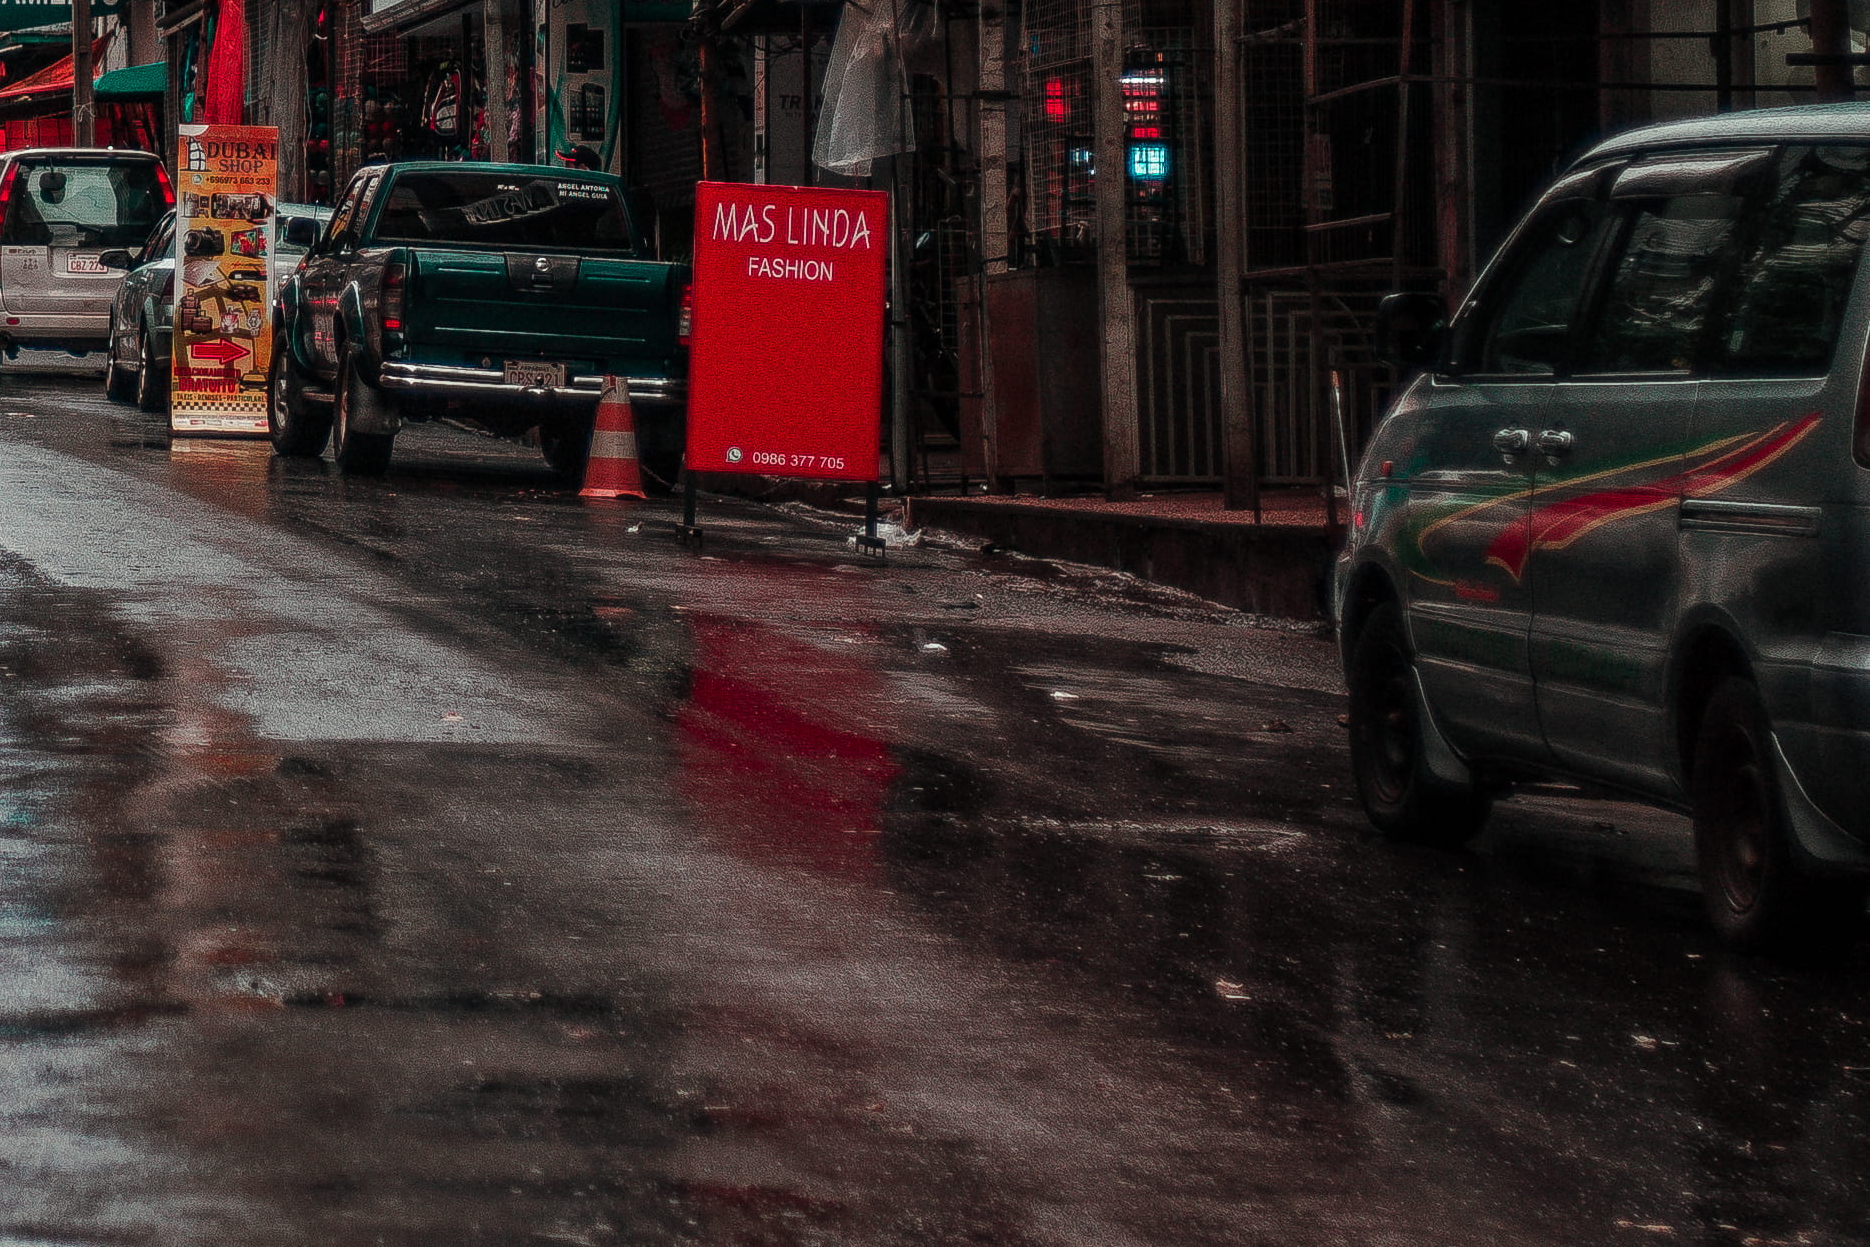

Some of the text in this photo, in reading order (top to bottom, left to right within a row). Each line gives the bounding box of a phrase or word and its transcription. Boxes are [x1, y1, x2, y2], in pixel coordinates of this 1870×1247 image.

[207, 141, 276, 160] DUBAI
[218, 159, 264, 174] SHOP
[712, 202, 871, 249] MAS LINDA
[748, 257, 834, 282] FASHION
[752, 451, 845, 469] 0986 377 705
